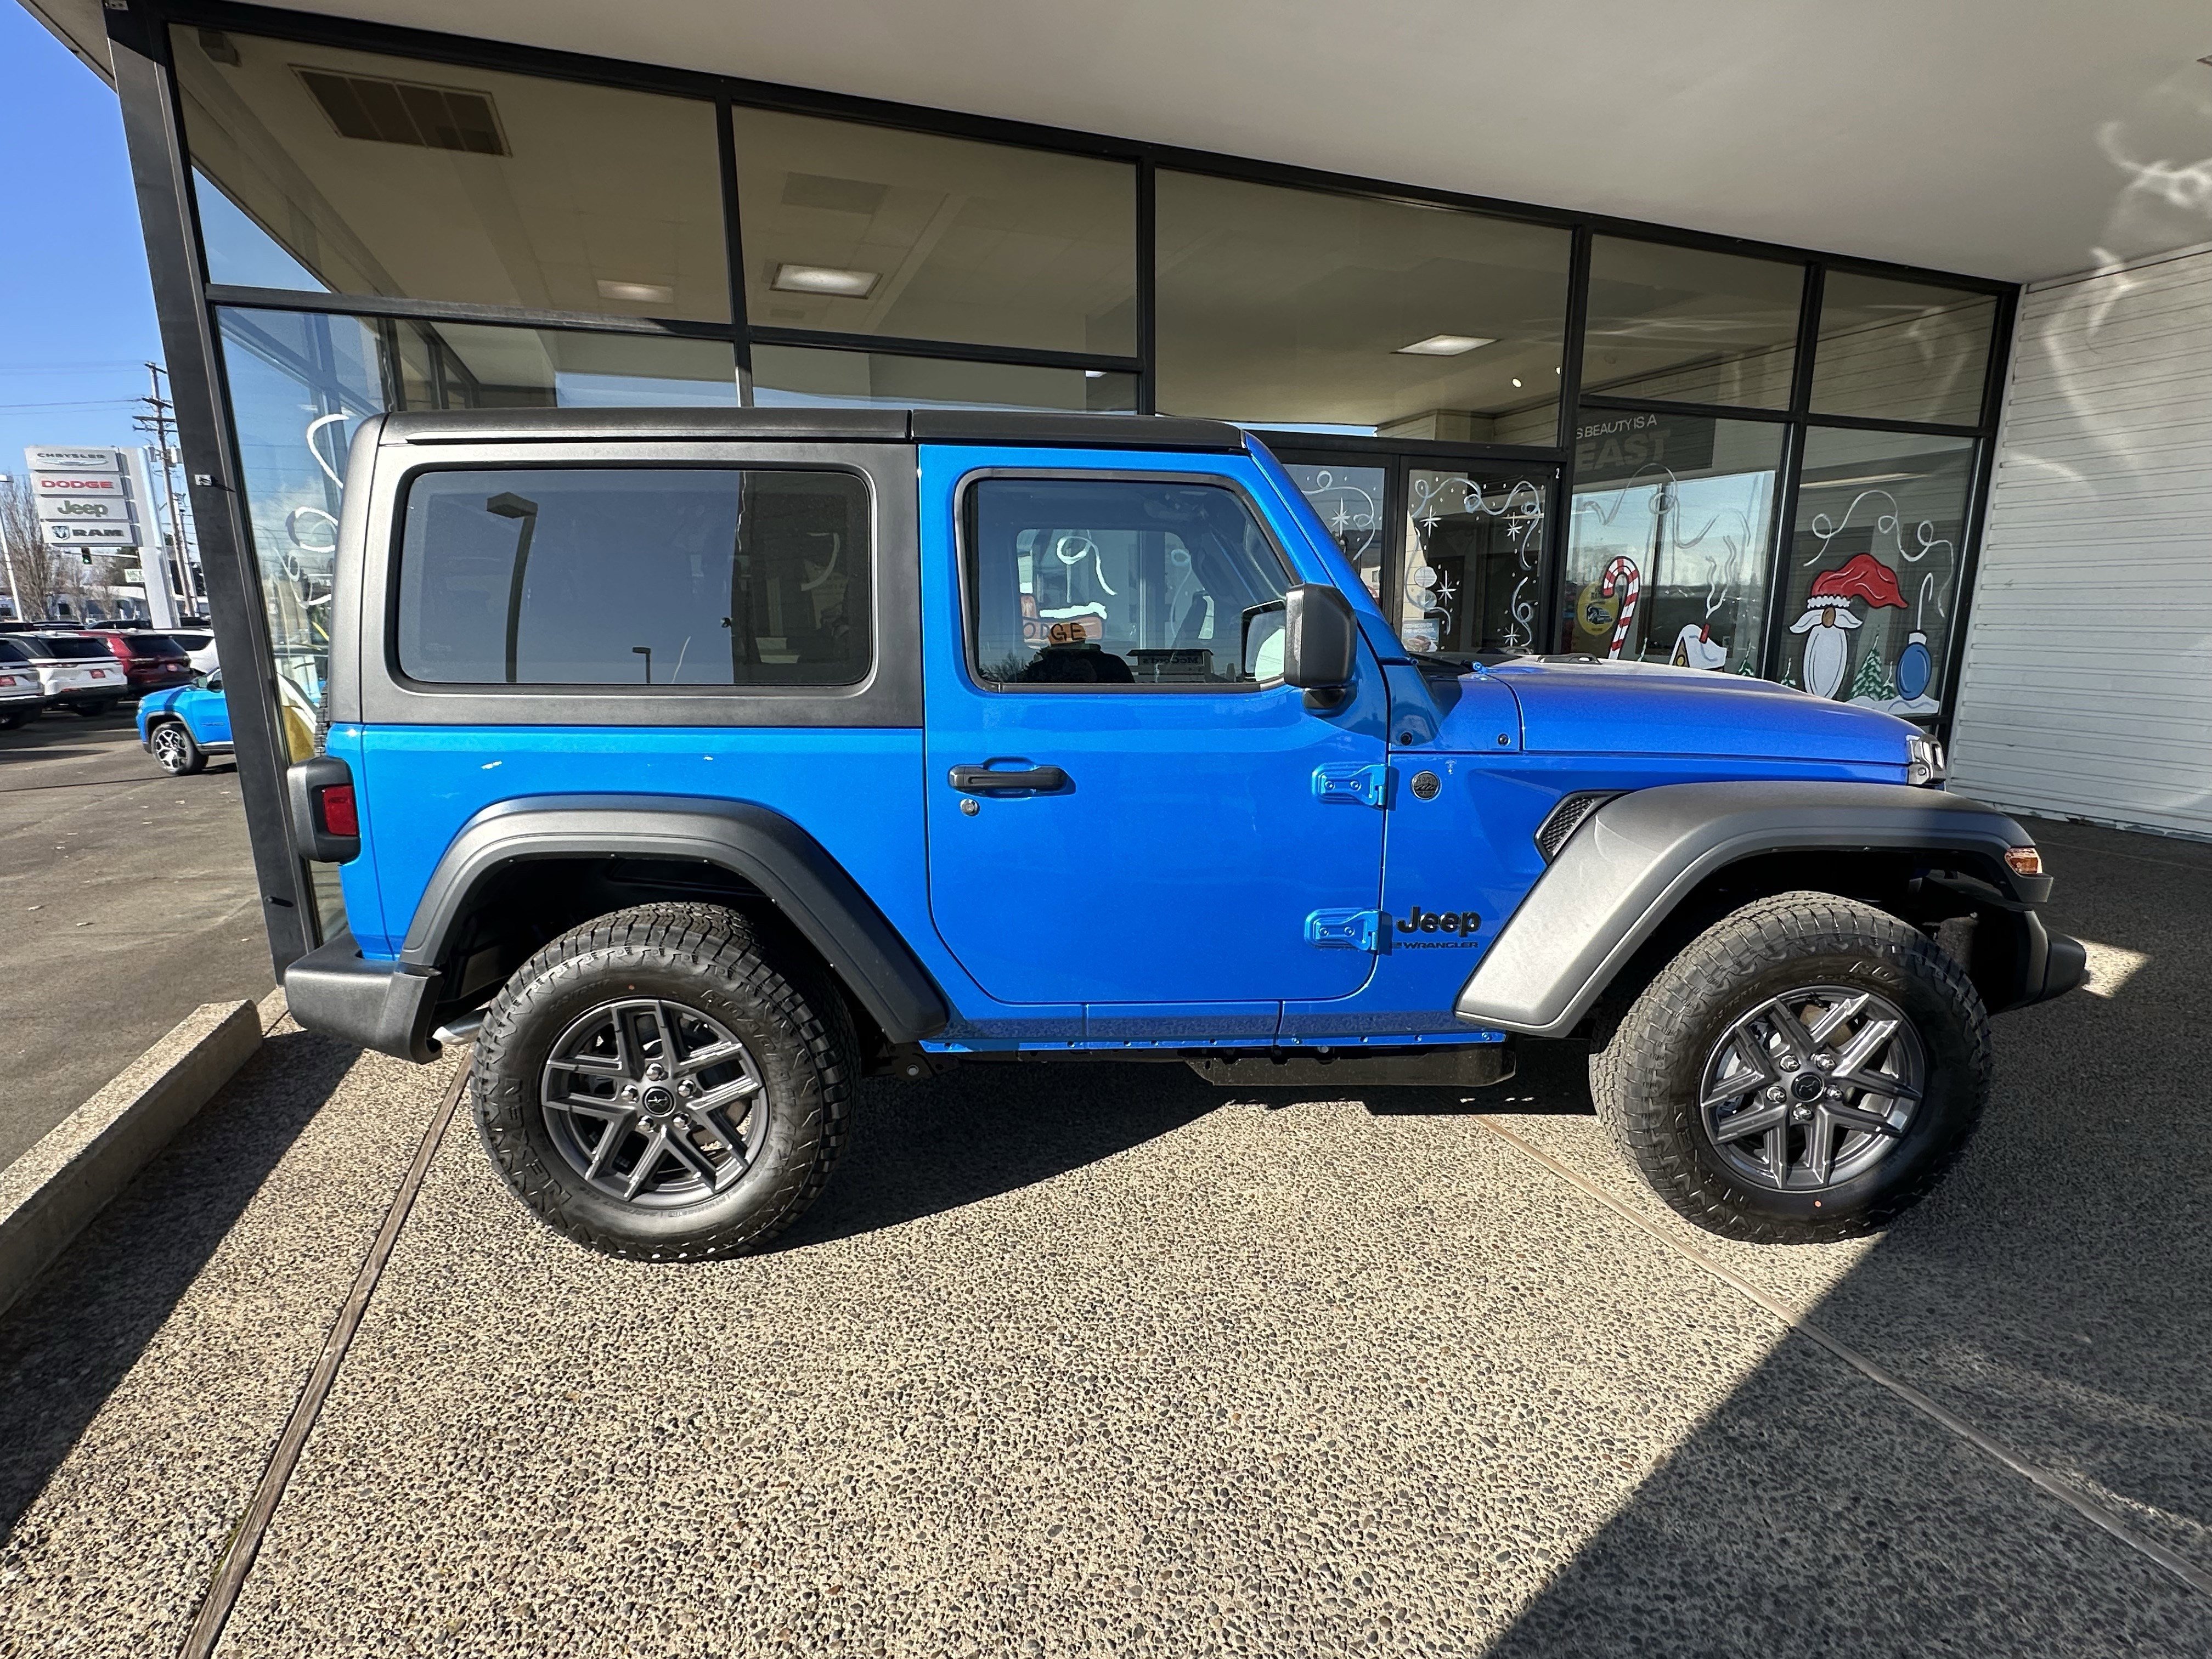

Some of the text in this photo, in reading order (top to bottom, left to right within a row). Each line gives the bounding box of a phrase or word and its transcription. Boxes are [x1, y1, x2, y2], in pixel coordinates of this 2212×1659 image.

[1584, 417, 1633, 438] BEAUTY
[1634, 416, 1645, 430] IS
[1646, 414, 1658, 427] A
[41, 480, 114, 489] DODGE
[57, 500, 109, 517] Jeep
[72, 528, 124, 537] RAM
[1396, 905, 1482, 938] Jeep
[504, 1077, 573, 1207] NEXEN
